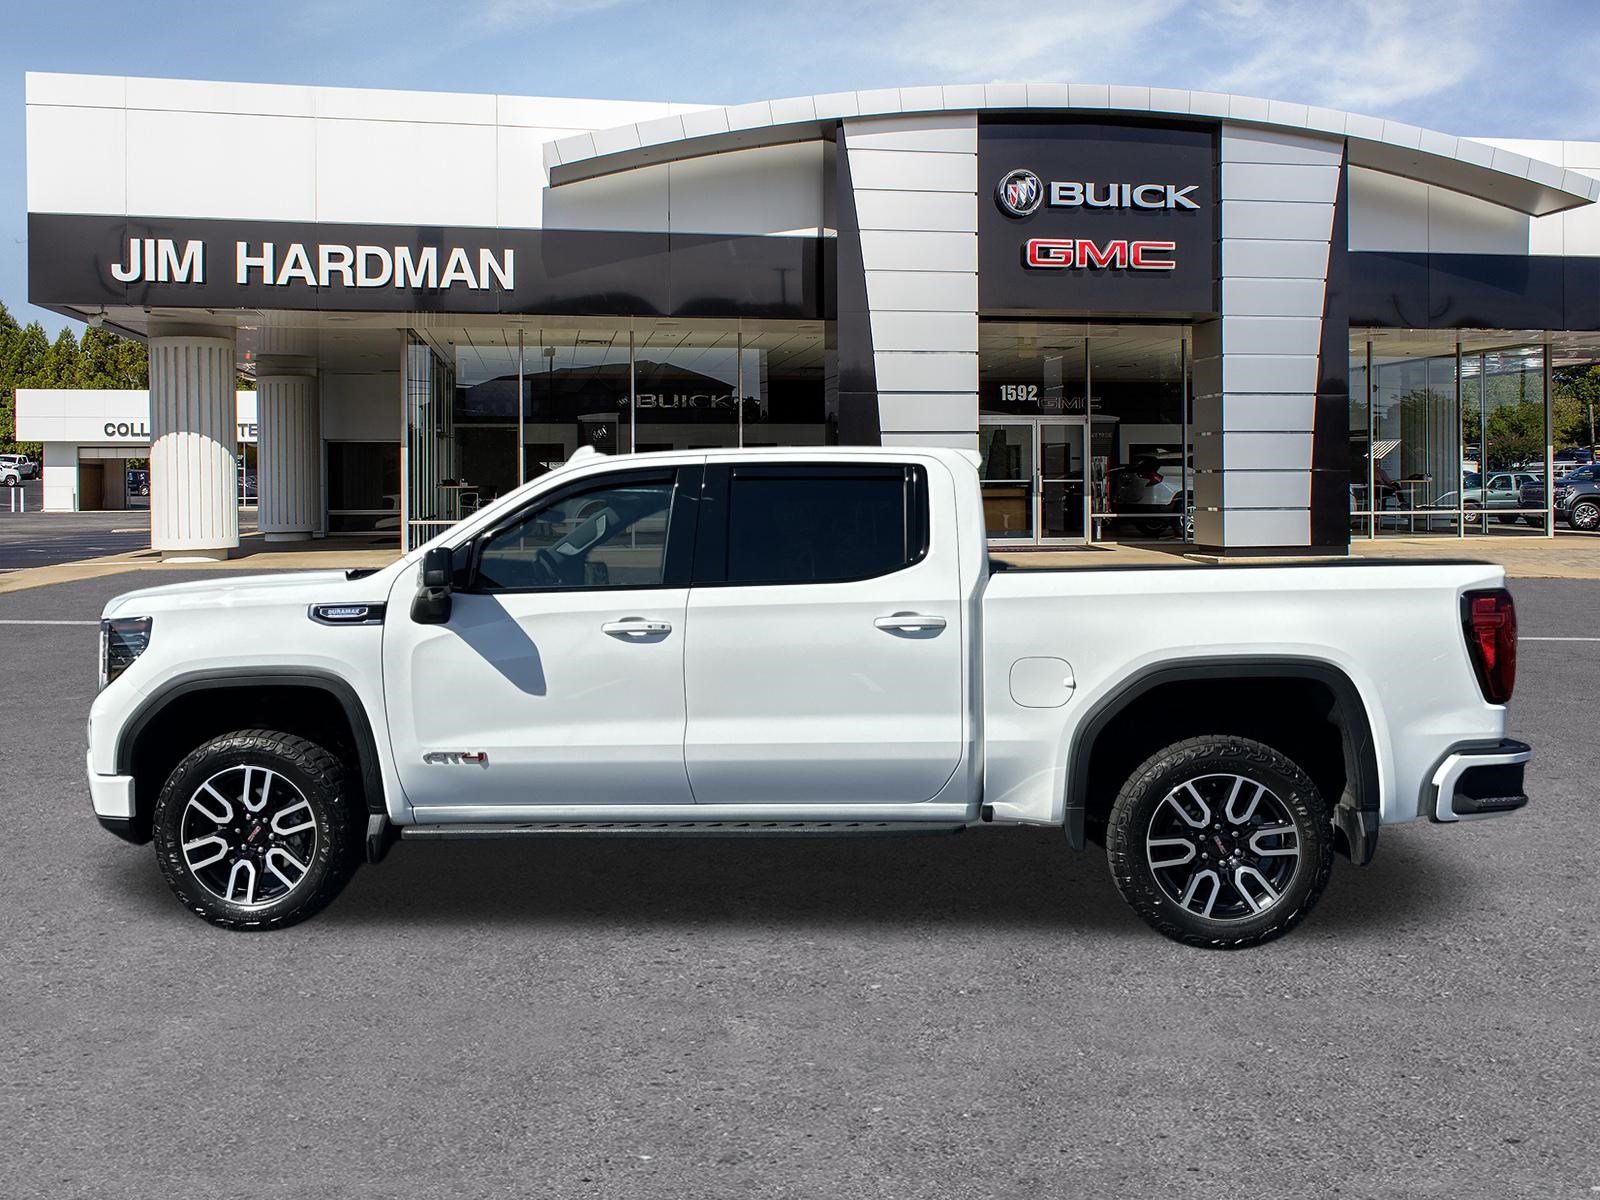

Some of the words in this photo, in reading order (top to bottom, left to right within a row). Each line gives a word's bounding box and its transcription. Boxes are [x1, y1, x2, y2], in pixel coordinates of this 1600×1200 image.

[1050, 181, 1200, 209] BUICK
[1027, 238, 1176, 269] GMC
[111, 239, 204, 283] JIM
[236, 242, 516, 290] HARDMAN
[1000, 384, 1038, 401] 1592
[636, 394, 732, 408] BUICK
[1037, 396, 1102, 409] GMC
[104, 422, 150, 437] COLL
[238, 423, 258, 437] TE
[423, 752, 486, 764] AT4
